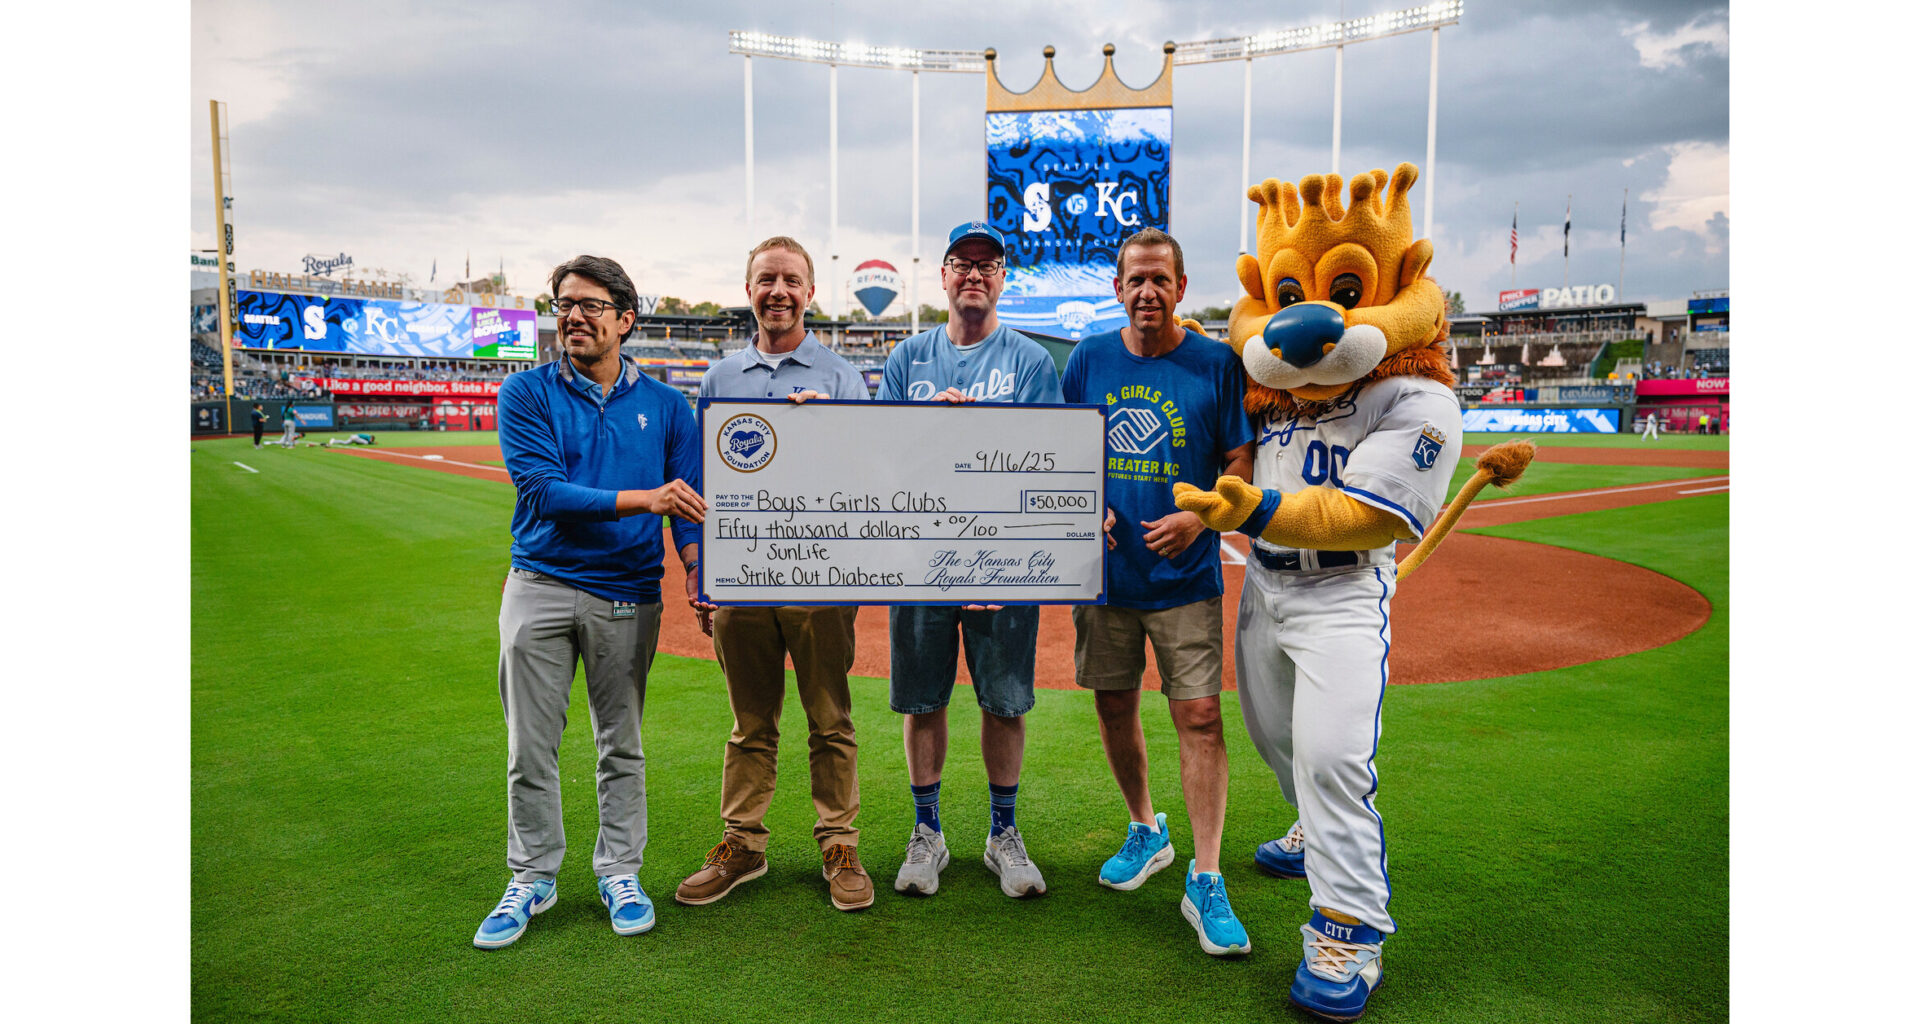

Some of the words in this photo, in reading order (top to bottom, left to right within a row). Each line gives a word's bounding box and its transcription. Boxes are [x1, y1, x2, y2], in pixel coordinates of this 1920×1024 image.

[1043, 162, 1111, 171] SEATTLE
[1023, 182, 1052, 233] S
[1071, 198, 1084, 212] VS
[1094, 182, 1138, 226] KC
[301, 252, 354, 277] Royals
[250, 269, 314, 291] HALL
[343, 278, 403, 299] FAME
[857, 274, 895, 283] RE/MAX
[444, 289, 464, 304] 20
[480, 292, 495, 306] 10
[515, 295, 525, 308] 5
[1500, 295, 1537, 310] CHOPPER
[1501, 290, 1523, 301] PRICE
[1542, 284, 1615, 307] PATIO
[244, 314, 280, 325] SEATTLE
[303, 305, 328, 340] S
[363, 307, 399, 343] KC
[323, 380, 350, 391] Like
[352, 383, 361, 391] a
[362, 381, 393, 394] good
[395, 381, 449, 394] neighbor,
[451, 382, 483, 393] State
[1696, 380, 1726, 389] NOW
[356, 406, 391, 417] State
[1106, 392, 1119, 406] &
[1121, 385, 1162, 404] GIRLS
[1161, 400, 1187, 448] CLUBS
[1503, 414, 1543, 426] KANSAS
[1543, 414, 1568, 426] CITY
[723, 418, 753, 437] KANSAS
[755, 420, 771, 436] CITY
[731, 434, 764, 452] Royals
[1415, 438, 1437, 466] KC
[723, 451, 771, 469] FOUNDATION
[976, 449, 1056, 472] 9/16/25
[1163, 462, 1180, 477] KC
[1302, 440, 1351, 489] 00
[1134, 473, 1152, 482] START
[1153, 476, 1169, 484] HERE
[757, 489, 806, 522] Boys
[830, 491, 881, 512] Girls
[891, 490, 947, 512] Clubs
[1029, 494, 1088, 511] $50,000
[718, 517, 758, 553] Fifty
[765, 520, 849, 539] thousand
[859, 519, 921, 540] dollars
[949, 515, 998, 538] 00/100
[766, 543, 830, 561] SunLife
[928, 549, 963, 569] The
[963, 549, 1024, 570] Kansas
[1027, 550, 1056, 574] City
[737, 564, 784, 587] Strike
[791, 566, 821, 586] Out
[828, 566, 904, 587] Diabetes
[924, 567, 977, 590] Royals
[979, 567, 1061, 585] Foundation
[1324, 921, 1353, 940] CITY
